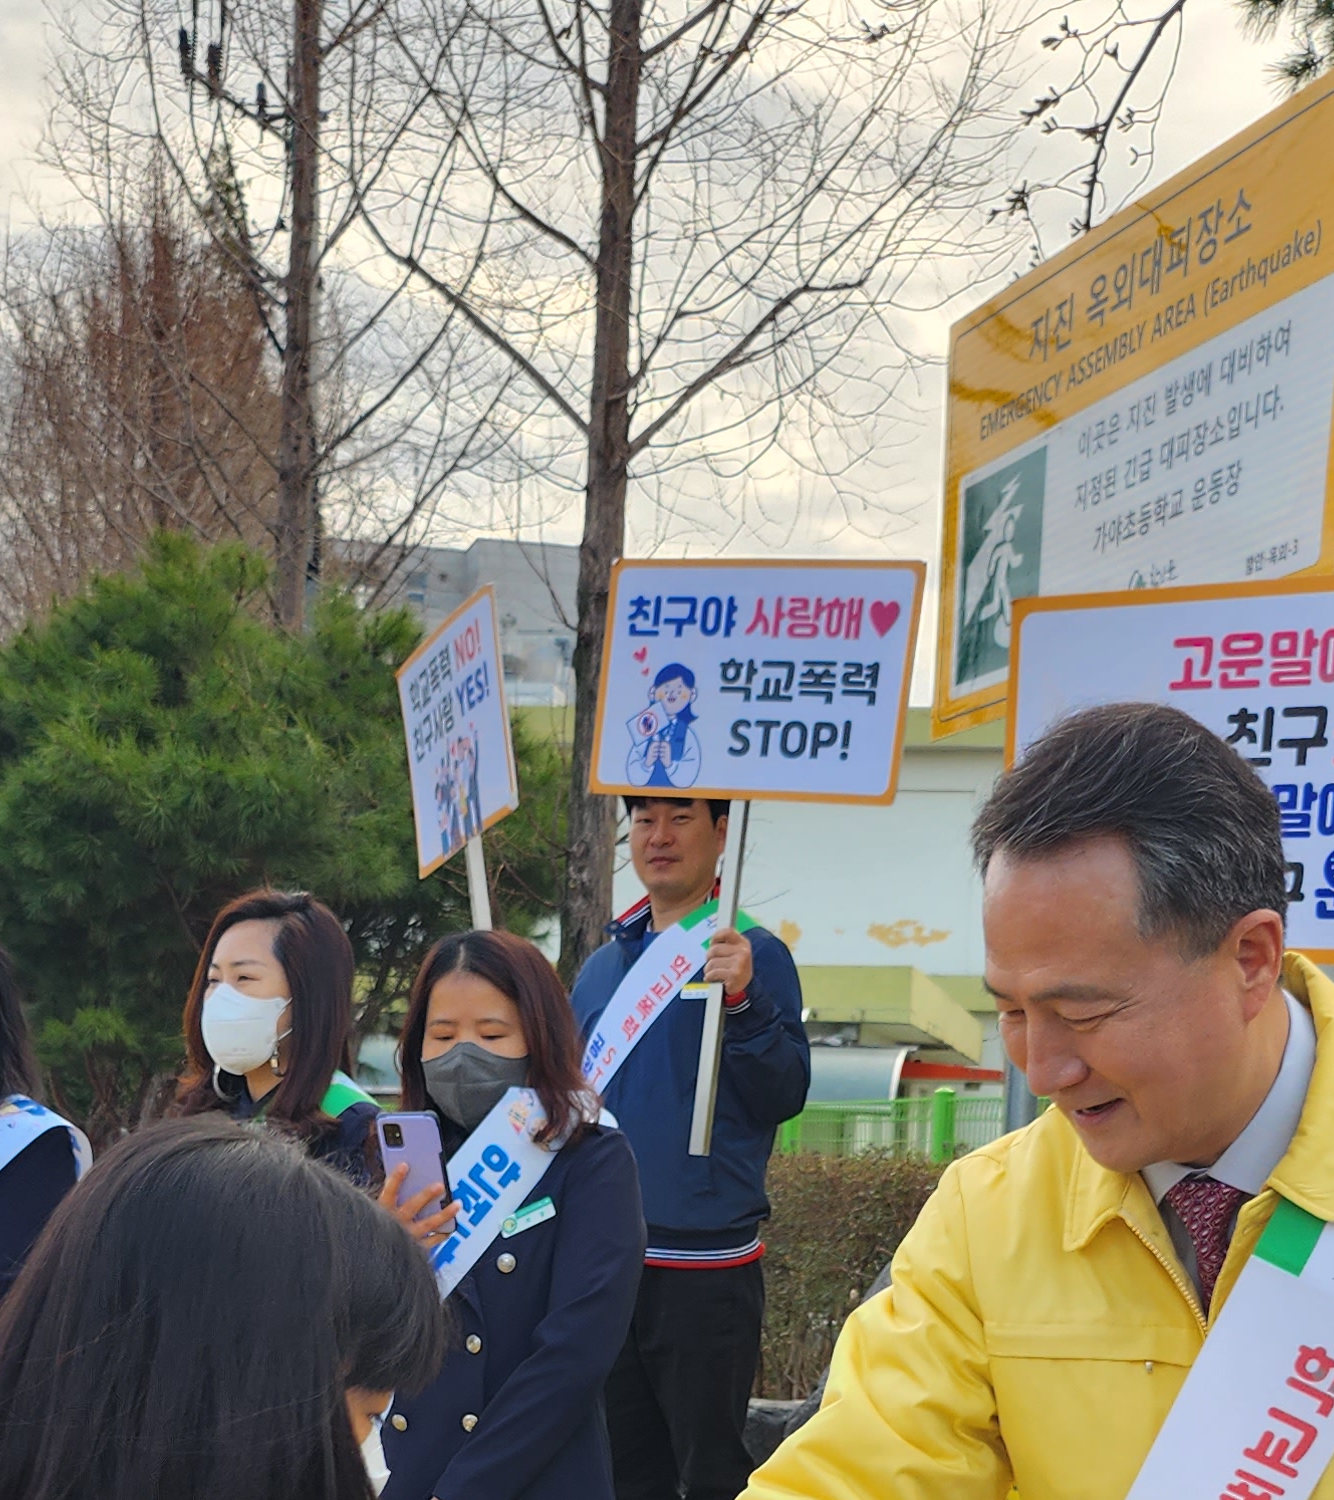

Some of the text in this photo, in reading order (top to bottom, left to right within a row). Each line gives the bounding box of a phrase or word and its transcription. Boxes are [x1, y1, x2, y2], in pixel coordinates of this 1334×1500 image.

[1029, 188, 1252, 361] 지진 옥외대피장소
[980, 220, 1323, 441] EMERGENCY ASSEMBLY AREA (Earthquake)
[1078, 319, 1292, 459] 이곳은 지진 발생에 대비하여
[1075, 384, 1285, 512] 지정된 긴급 대피장소입니다.
[1093, 459, 1243, 554] 가야초등학교 운동장
[454, 617, 482, 672] NO!
[627, 595, 864, 640] 친구야 사랑해
[456, 660, 490, 717] YES!
[719, 658, 880, 705] 학교폭력
[728, 720, 851, 760] STOP!
[622, 954, 692, 1042] 학교폭력
